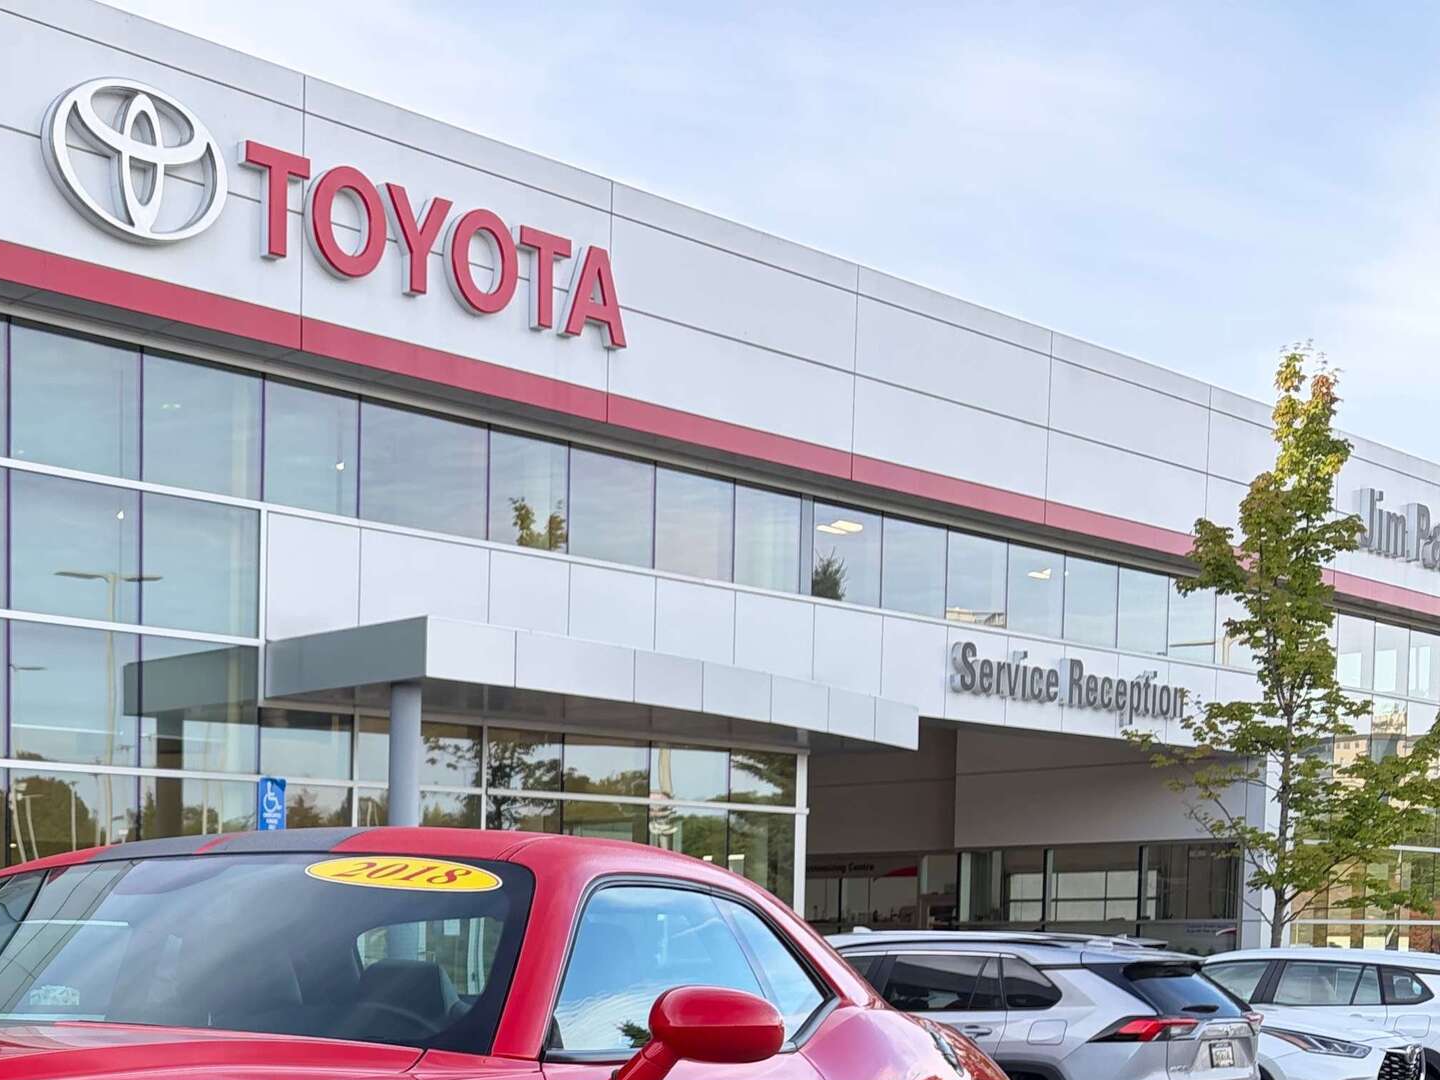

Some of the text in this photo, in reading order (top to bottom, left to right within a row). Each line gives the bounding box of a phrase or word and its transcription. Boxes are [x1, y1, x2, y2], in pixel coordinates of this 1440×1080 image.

[237, 139, 627, 350] TOYOTA
[1359, 487, 1407, 556] Jim
[953, 641, 1186, 725] Service Reception
[331, 861, 473, 885] 2018
